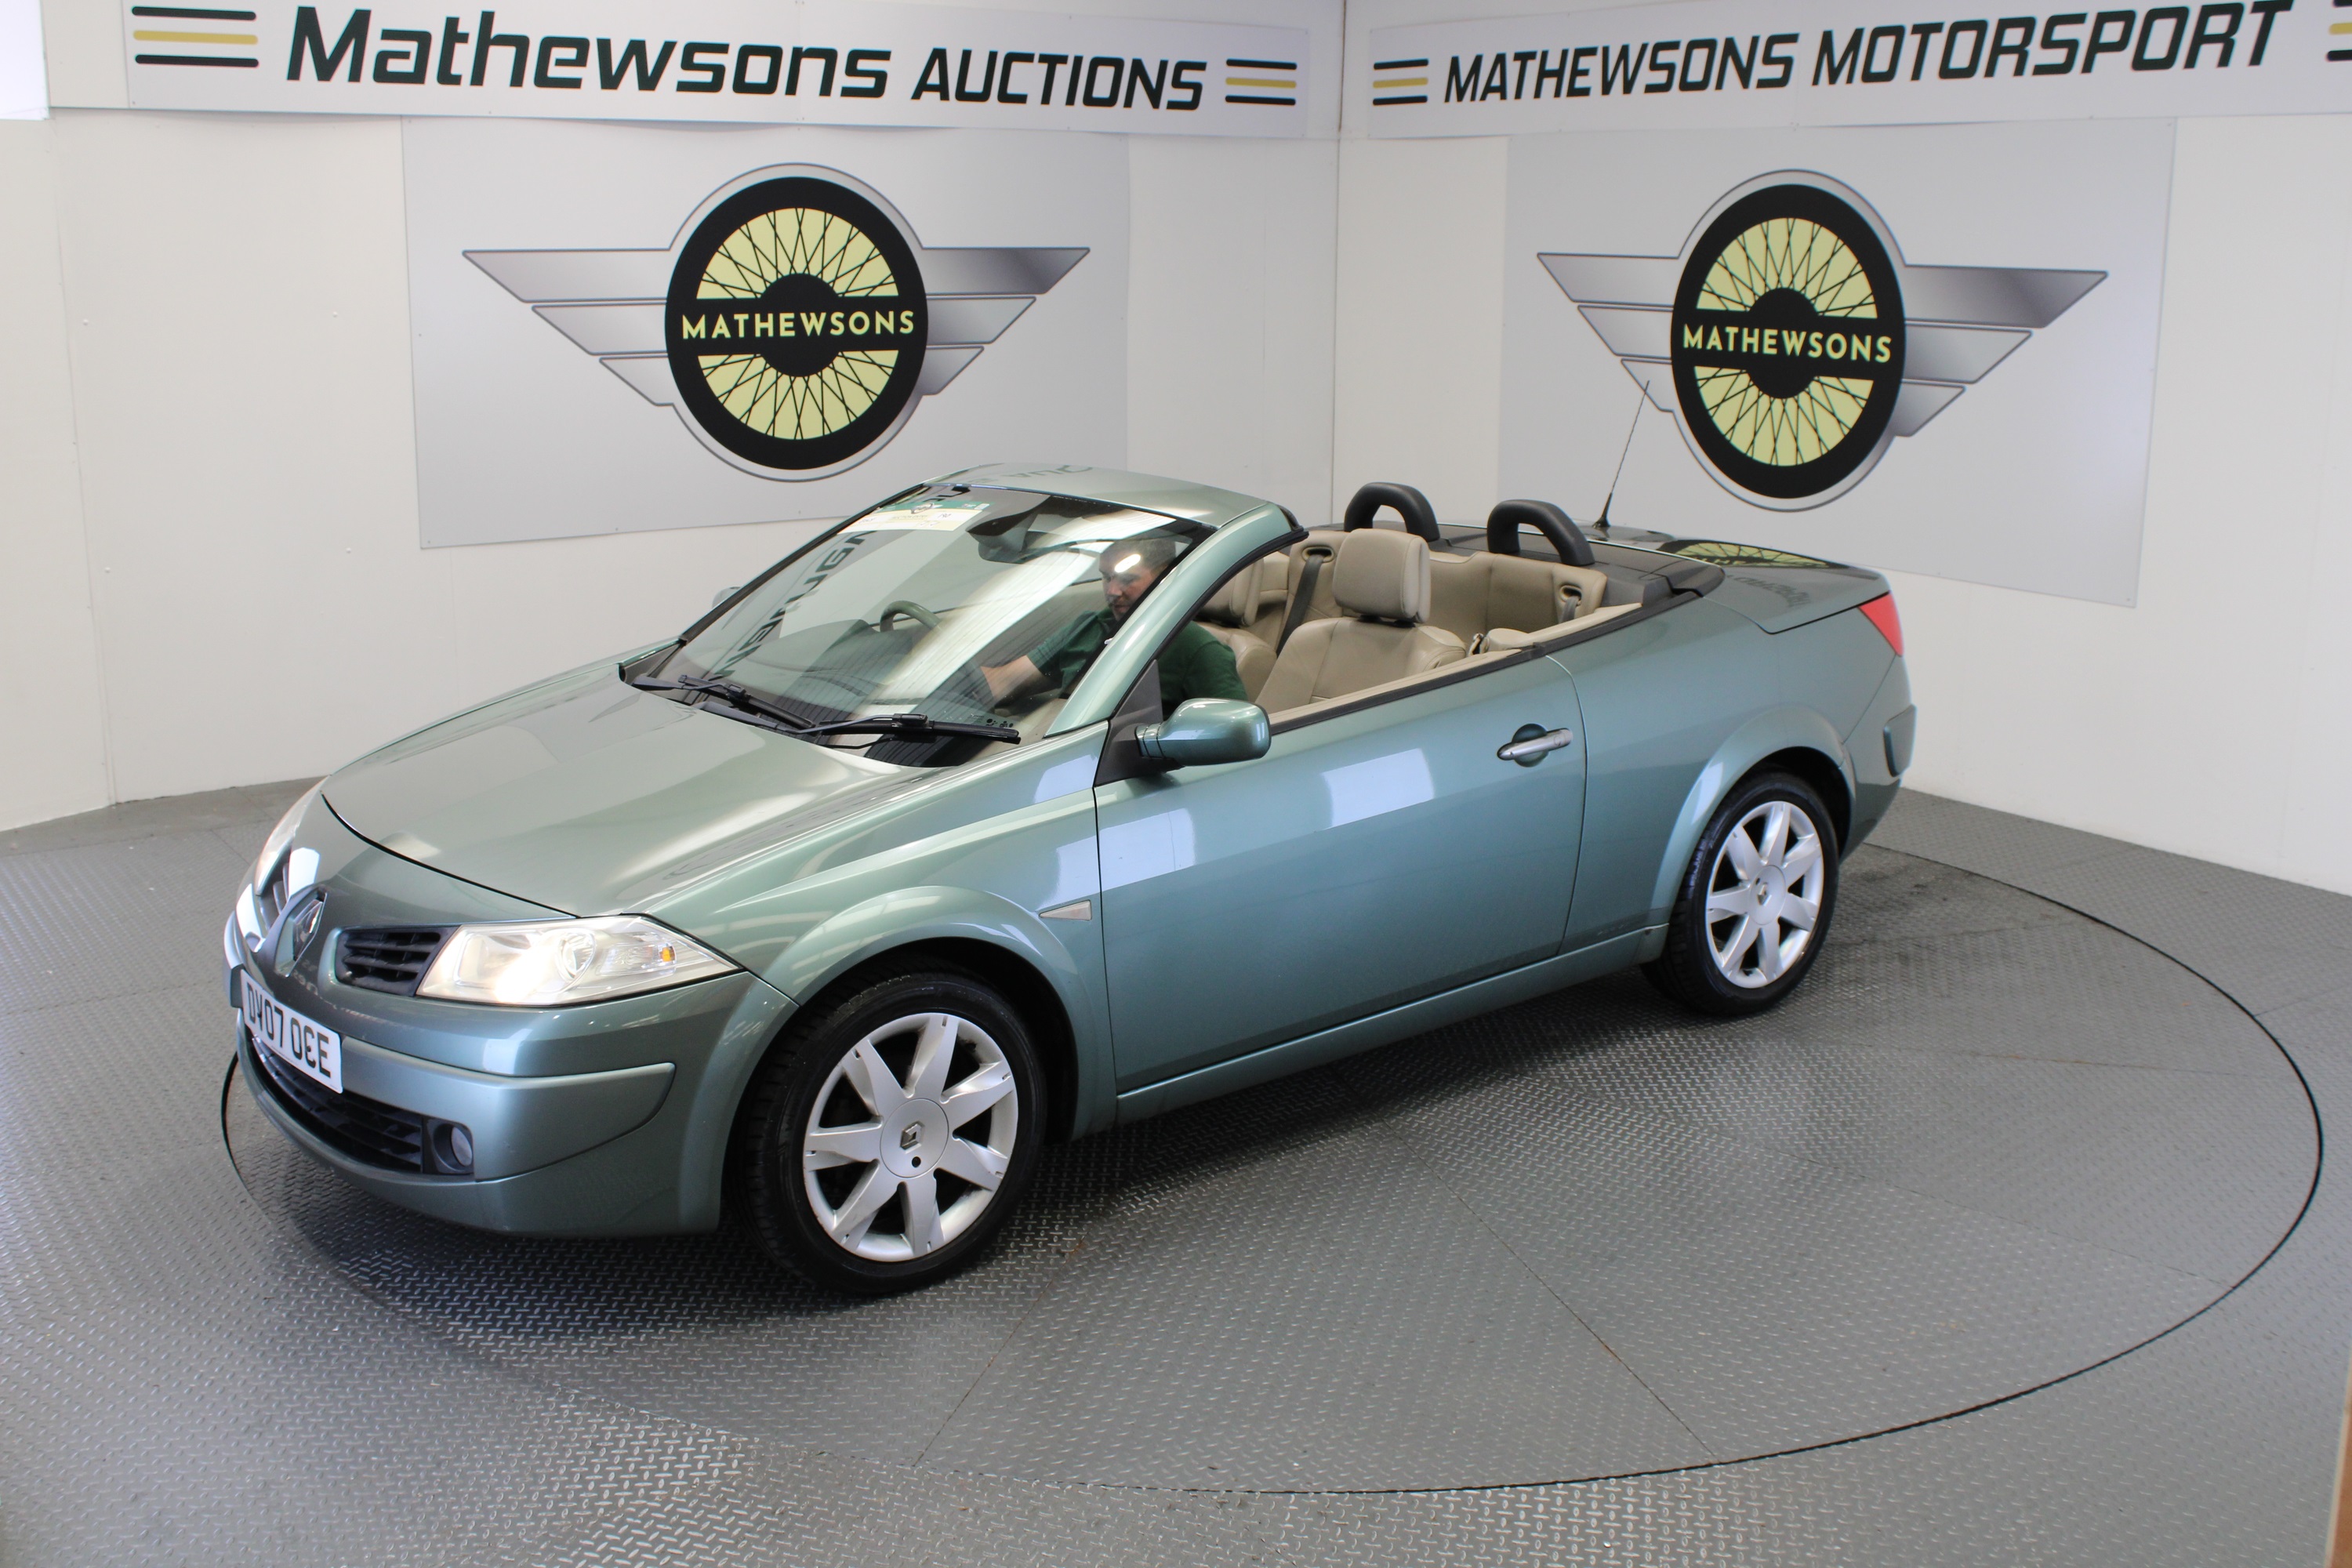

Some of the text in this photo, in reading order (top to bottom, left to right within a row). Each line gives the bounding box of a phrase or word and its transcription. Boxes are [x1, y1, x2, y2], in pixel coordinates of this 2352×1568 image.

[287, 6, 1208, 111] Mathewsons AUCTIONS
[1444, 0, 2294, 103] MATHEWSONS MOTORSPORT
[681, 309, 916, 340] MATHEWSONS
[1682, 323, 1893, 363] MATHEWSONS
